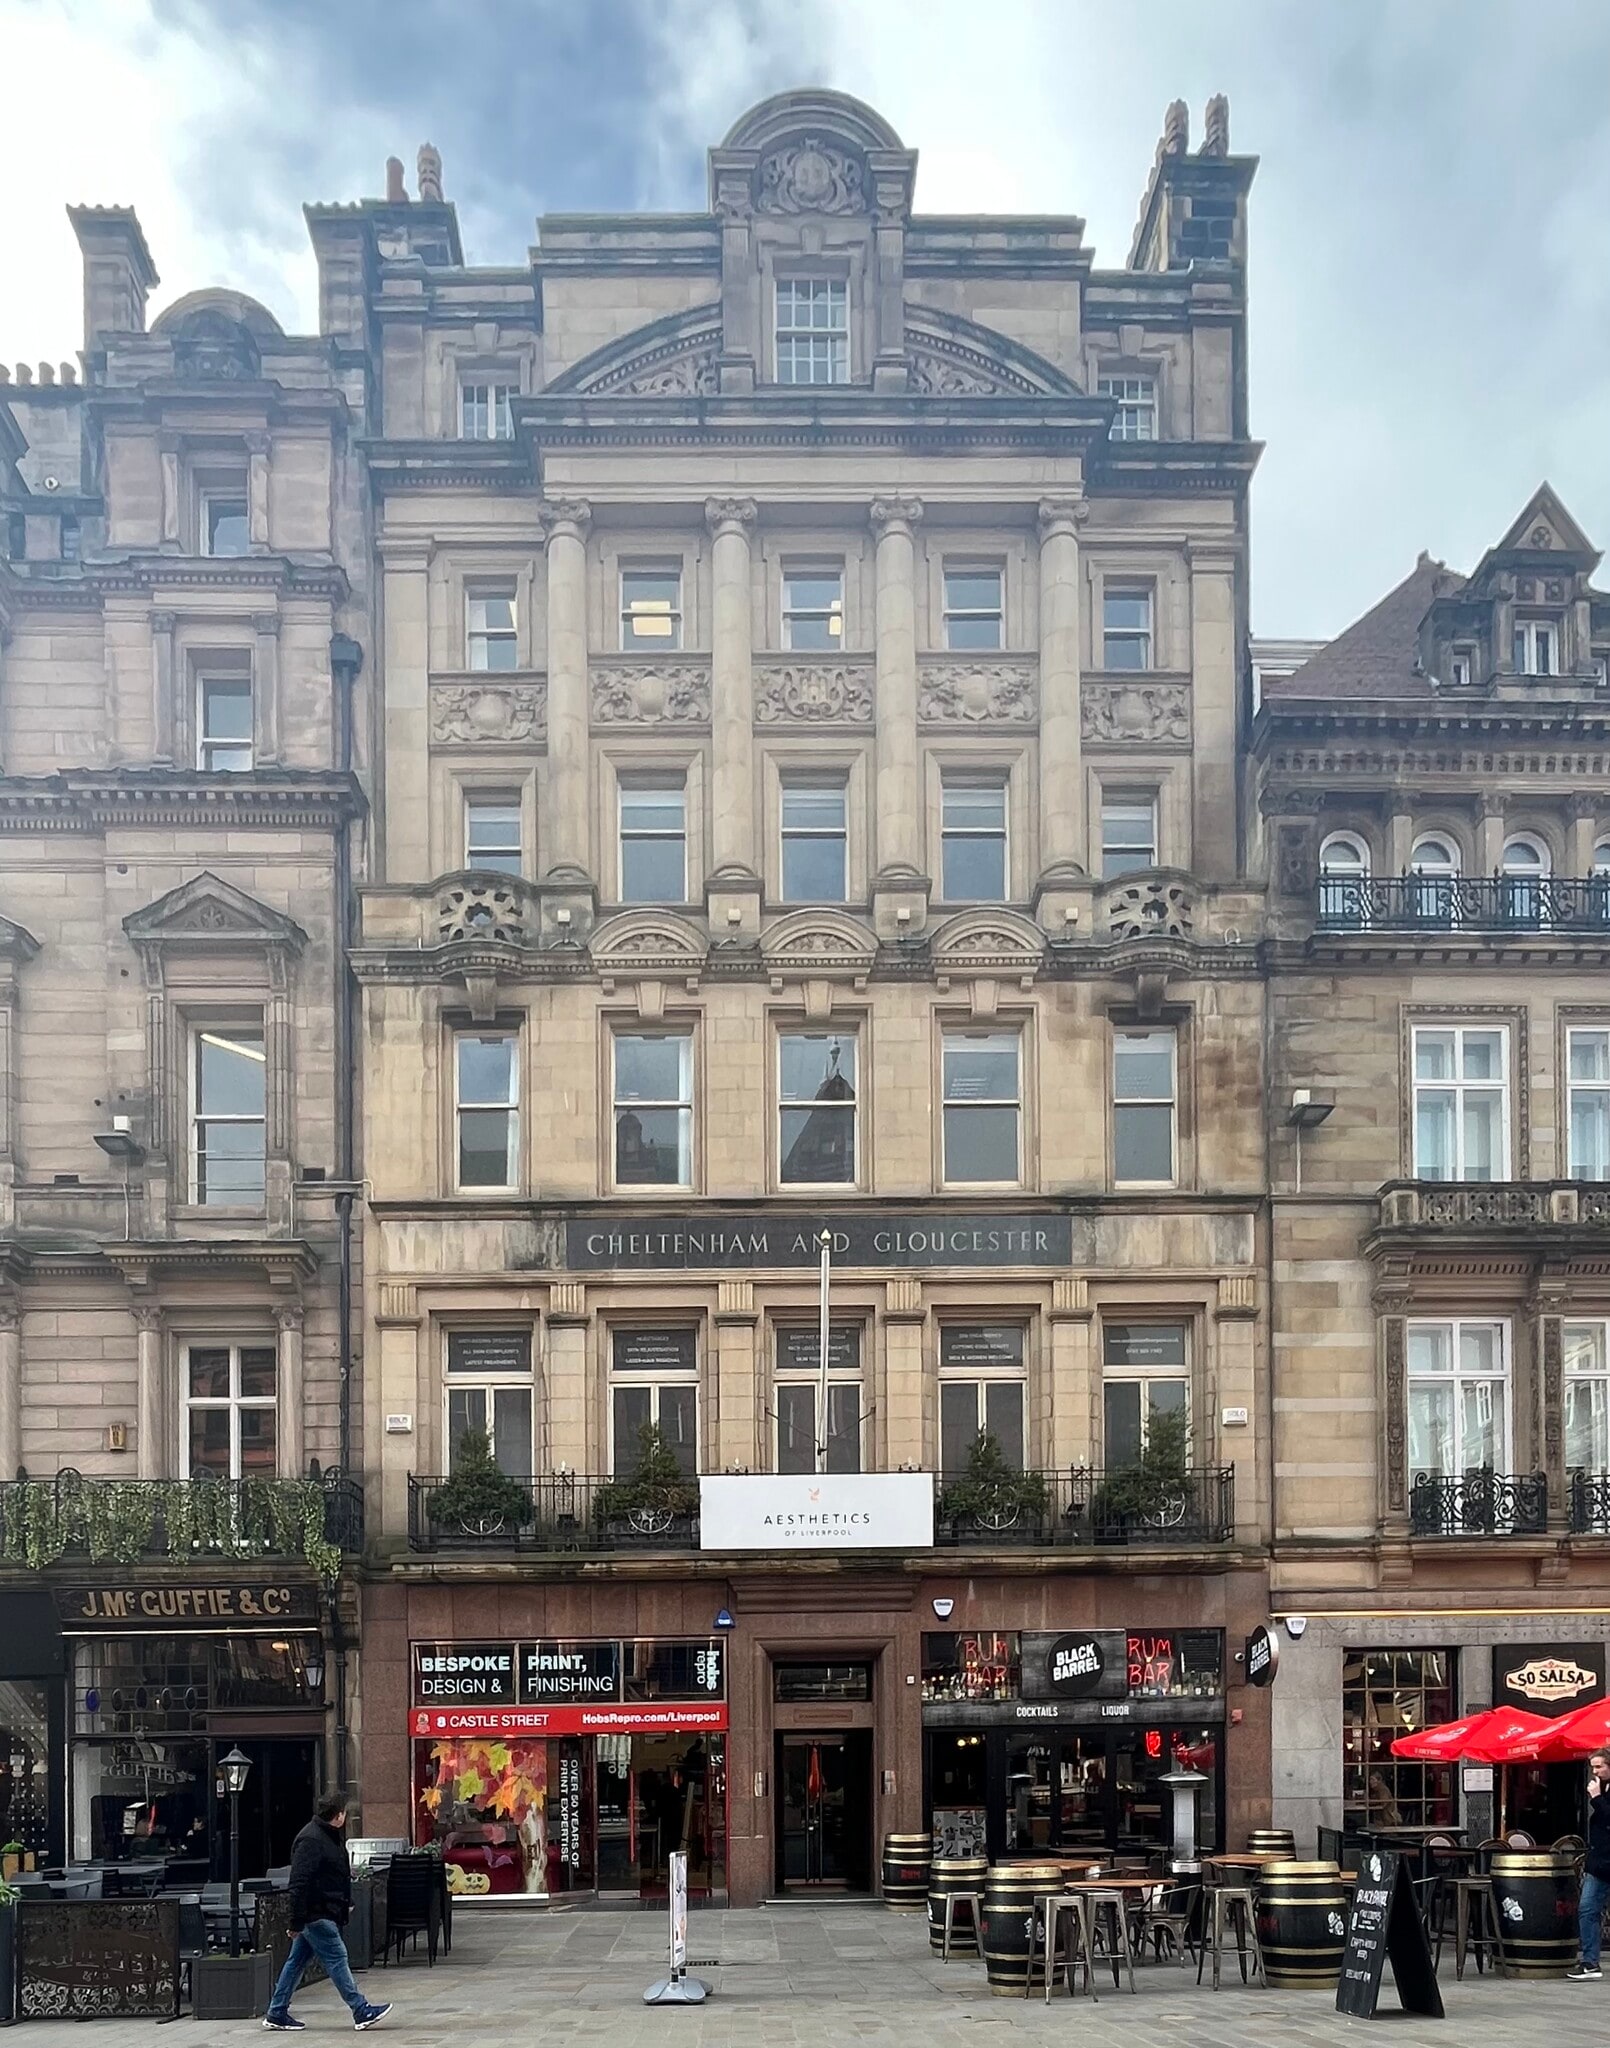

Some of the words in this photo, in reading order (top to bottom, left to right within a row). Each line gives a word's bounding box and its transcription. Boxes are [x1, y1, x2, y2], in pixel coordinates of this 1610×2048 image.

[586, 1233, 769, 1255] CHELTENHAM
[791, 1232, 850, 1253] AND
[873, 1231, 1049, 1253] GLOUCESTER
[763, 1513, 871, 1525] AESTHETICS
[800, 1529, 853, 1537] LIVERPOOL
[141, 1589, 235, 1616] GUFFIE
[238, 1588, 263, 1615] &
[964, 1639, 1008, 1662] RUM
[1055, 1642, 1095, 1667] BLACK
[1127, 1636, 1173, 1662] RUM
[421, 1655, 511, 1672] BESPOKE
[527, 1654, 588, 1673] PRINT,
[694, 1650, 706, 1685] repro
[706, 1650, 720, 1691] hobs
[1053, 1656, 1101, 1682] BARREL
[421, 1677, 487, 1695] DESIGN
[490, 1678, 503, 1694] &
[527, 1676, 614, 1693] FINISHING
[1128, 1662, 1170, 1689] BAR
[1517, 1671, 1536, 1687] SO
[1539, 1669, 1586, 1686] SALSA
[436, 1716, 447, 1728] 8
[449, 1715, 499, 1728] CASTLE
[501, 1714, 550, 1727] STREET
[582, 1711, 721, 1725] HobsRepro.com/Liverpool
[1016, 1706, 1059, 1718] COCKTAILS
[1101, 1705, 1130, 1716] LIQUOR
[560, 1759, 569, 1794] PRINT
[570, 1759, 580, 1792] OVER
[570, 1794, 580, 1808] 50
[560, 1798, 569, 1862] EXPERTISE
[570, 1810, 580, 1850] YEARS
[571, 1852, 580, 1869] OF
